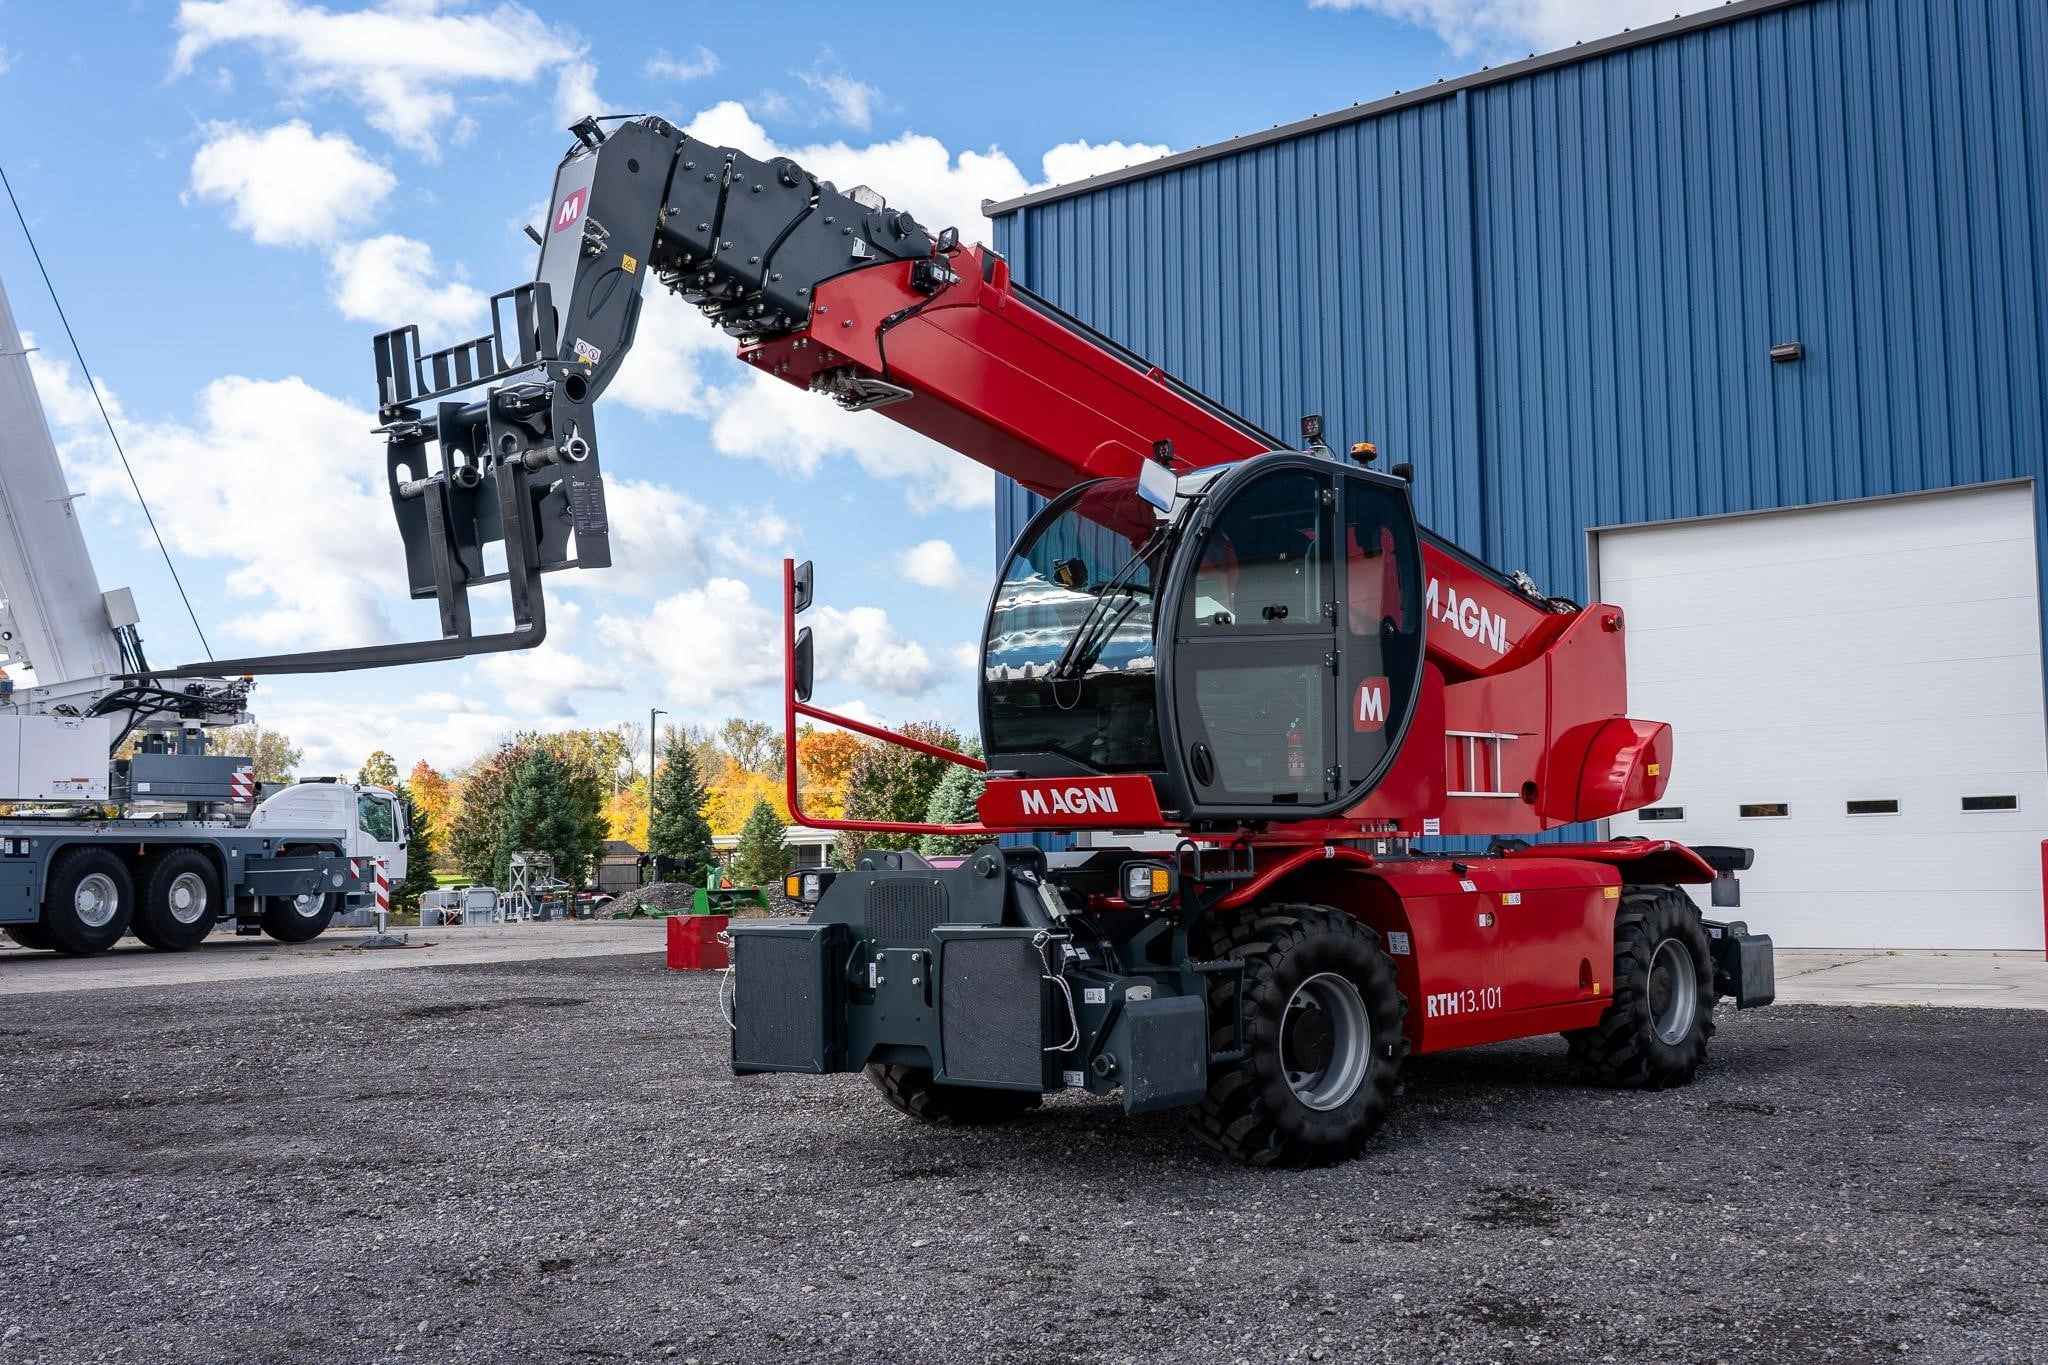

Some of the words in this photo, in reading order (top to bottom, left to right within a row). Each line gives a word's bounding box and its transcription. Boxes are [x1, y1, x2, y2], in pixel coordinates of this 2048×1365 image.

[559, 197, 578, 224] M
[1360, 687, 1383, 721] M
[1021, 787, 1119, 815] MAGNI
